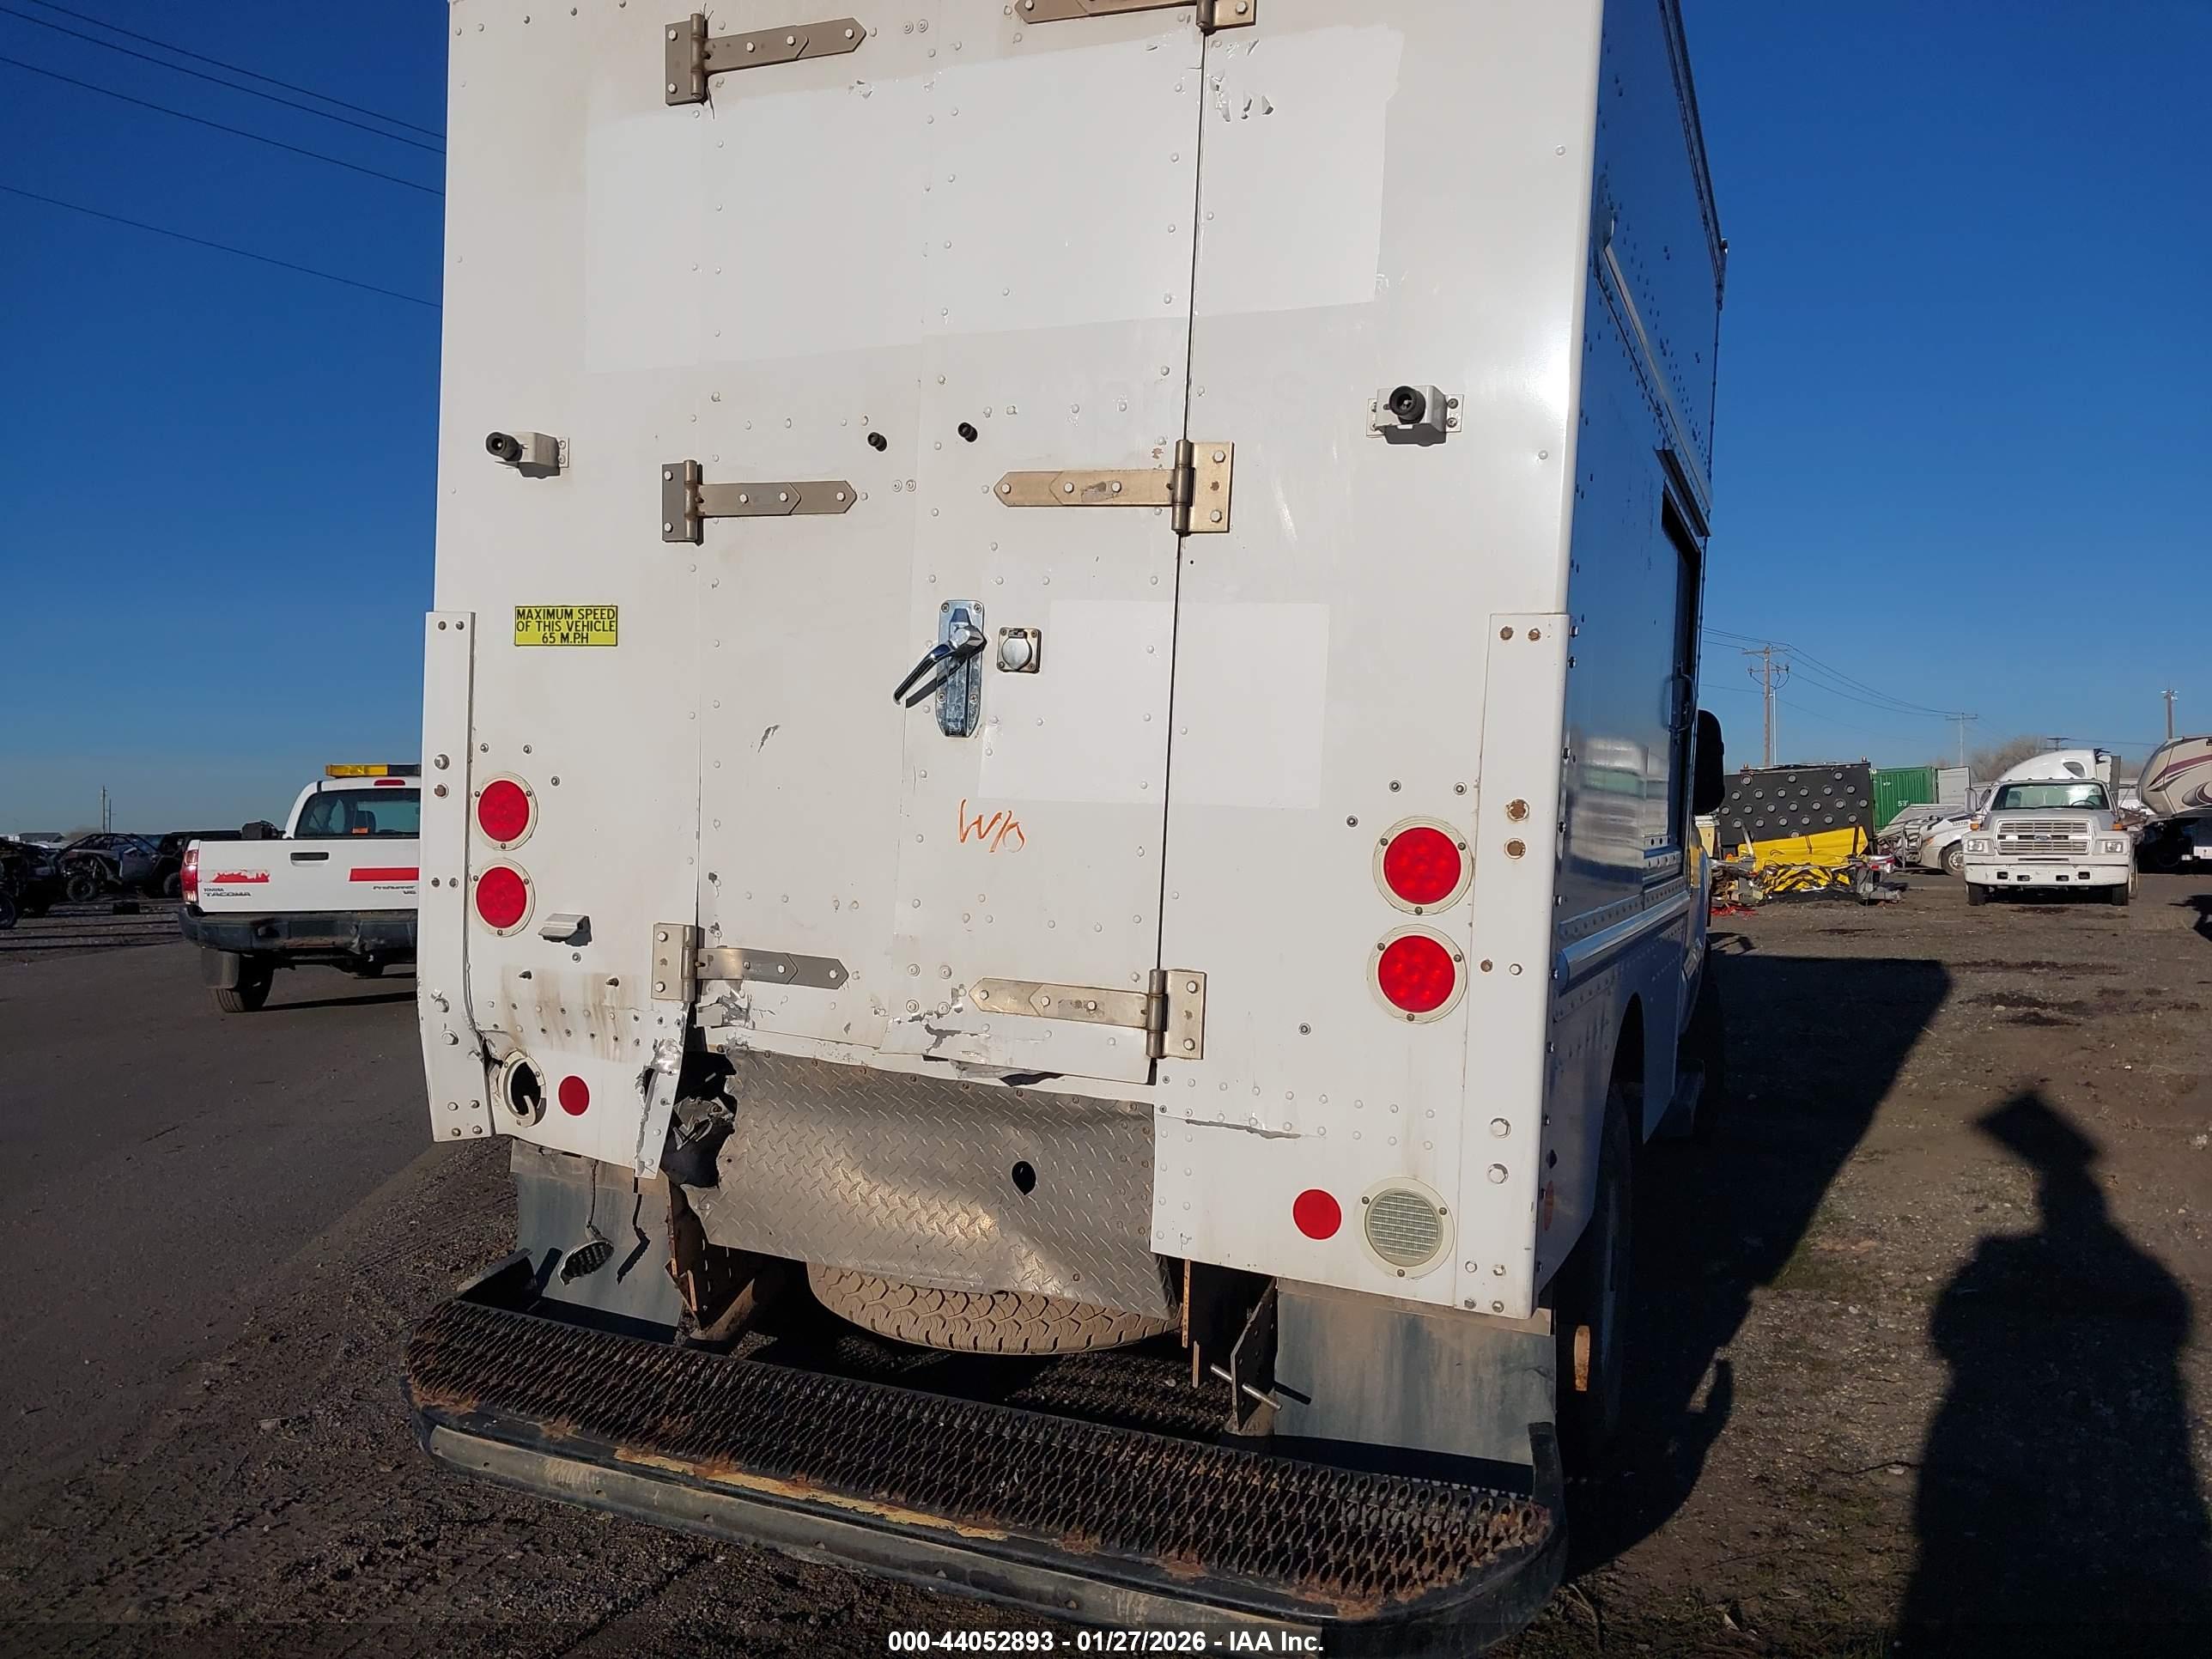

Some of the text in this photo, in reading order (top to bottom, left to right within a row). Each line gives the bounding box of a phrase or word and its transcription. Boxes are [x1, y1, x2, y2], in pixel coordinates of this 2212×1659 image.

[516, 608, 616, 620] MAXIMUM SPEED
[516, 620, 616, 632] OF THIS VEHICLE
[542, 632, 556, 644] 65
